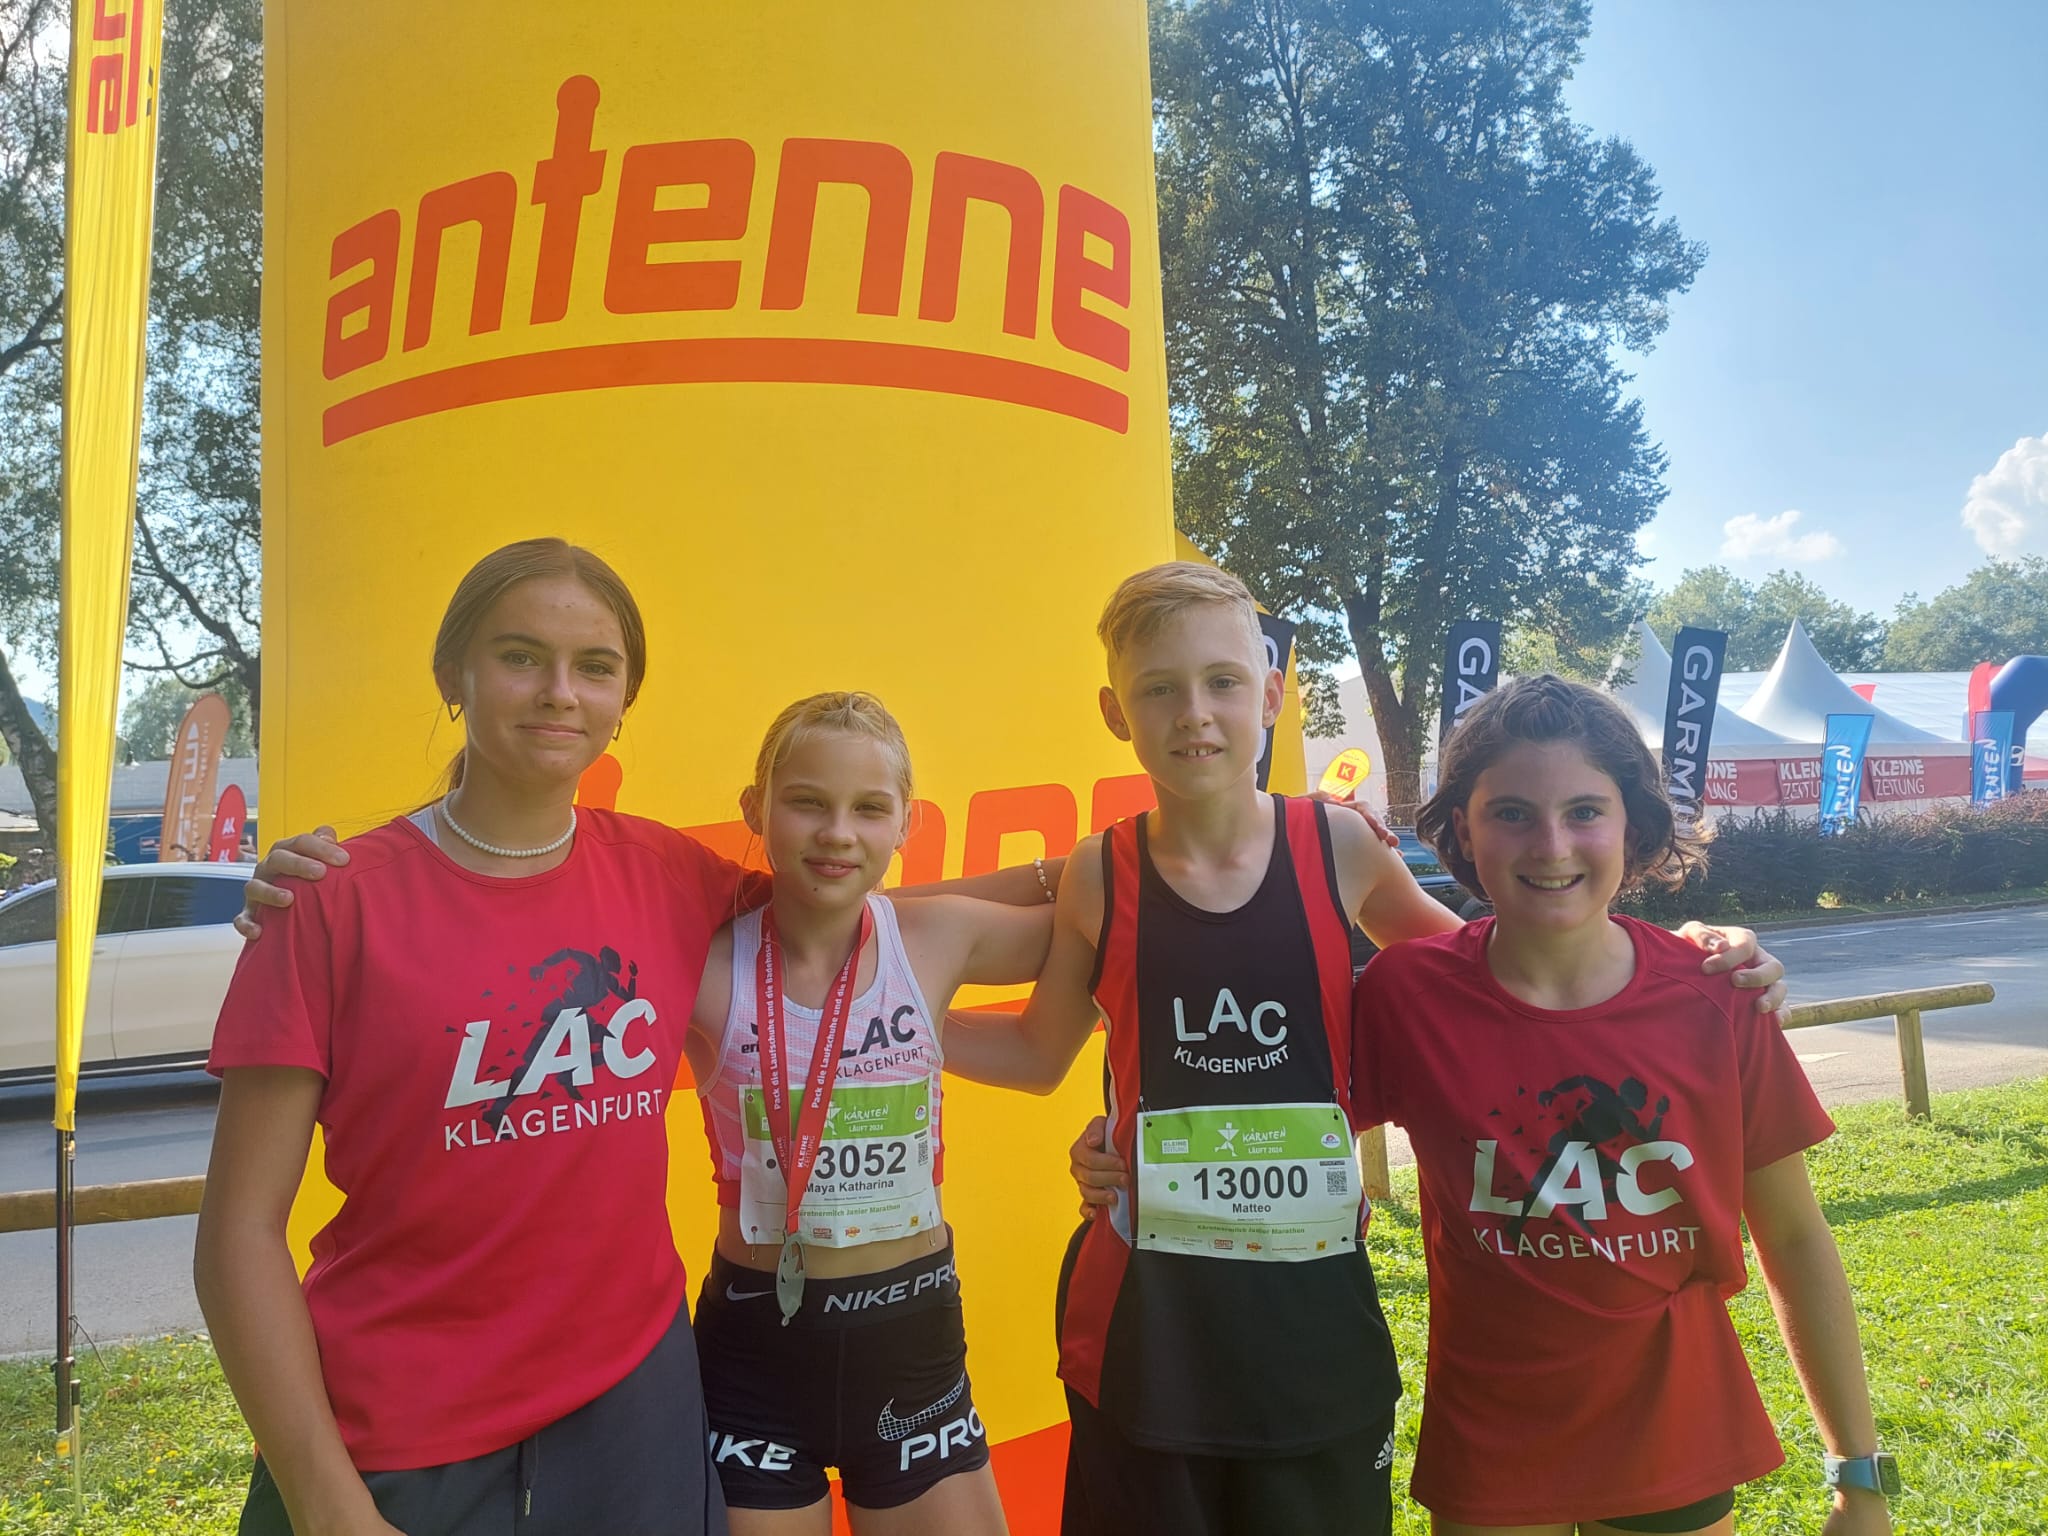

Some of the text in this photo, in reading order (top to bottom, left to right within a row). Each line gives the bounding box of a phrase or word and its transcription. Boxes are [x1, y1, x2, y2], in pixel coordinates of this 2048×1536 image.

[322, 74, 1131, 381] antenne
[1704, 762, 1737, 779] INE
[1871, 759, 1925, 777] KLEINE
[1874, 778, 1925, 797] ZEITUNG
[765, 983, 774, 998] die
[837, 982, 847, 997] die
[766, 1000, 774, 1018] und
[833, 998, 843, 1016] und
[1174, 987, 1288, 1046] LAC
[444, 998, 657, 1109] LAC
[768, 1020, 777, 1067] Laufschuhe
[820, 1018, 839, 1068] Laufschuhe
[1174, 1044, 1289, 1074] KLAGENFURT
[771, 1070, 779, 1085] die
[816, 1069, 827, 1085] die
[773, 1088, 782, 1110] Pack
[811, 1088, 824, 1109] Pack
[445, 1089, 663, 1151] KLAGENFURT
[797, 1135, 809, 1169] KLEINE
[804, 1180, 894, 1195] Maya Katharina
[1193, 1165, 1308, 1201] 13000
[1468, 1139, 1694, 1221] LAC
[1232, 1203, 1272, 1214] Matteo
[1472, 1227, 1700, 1263] KLAGENFURT
[824, 1280, 910, 1313] NIKE
